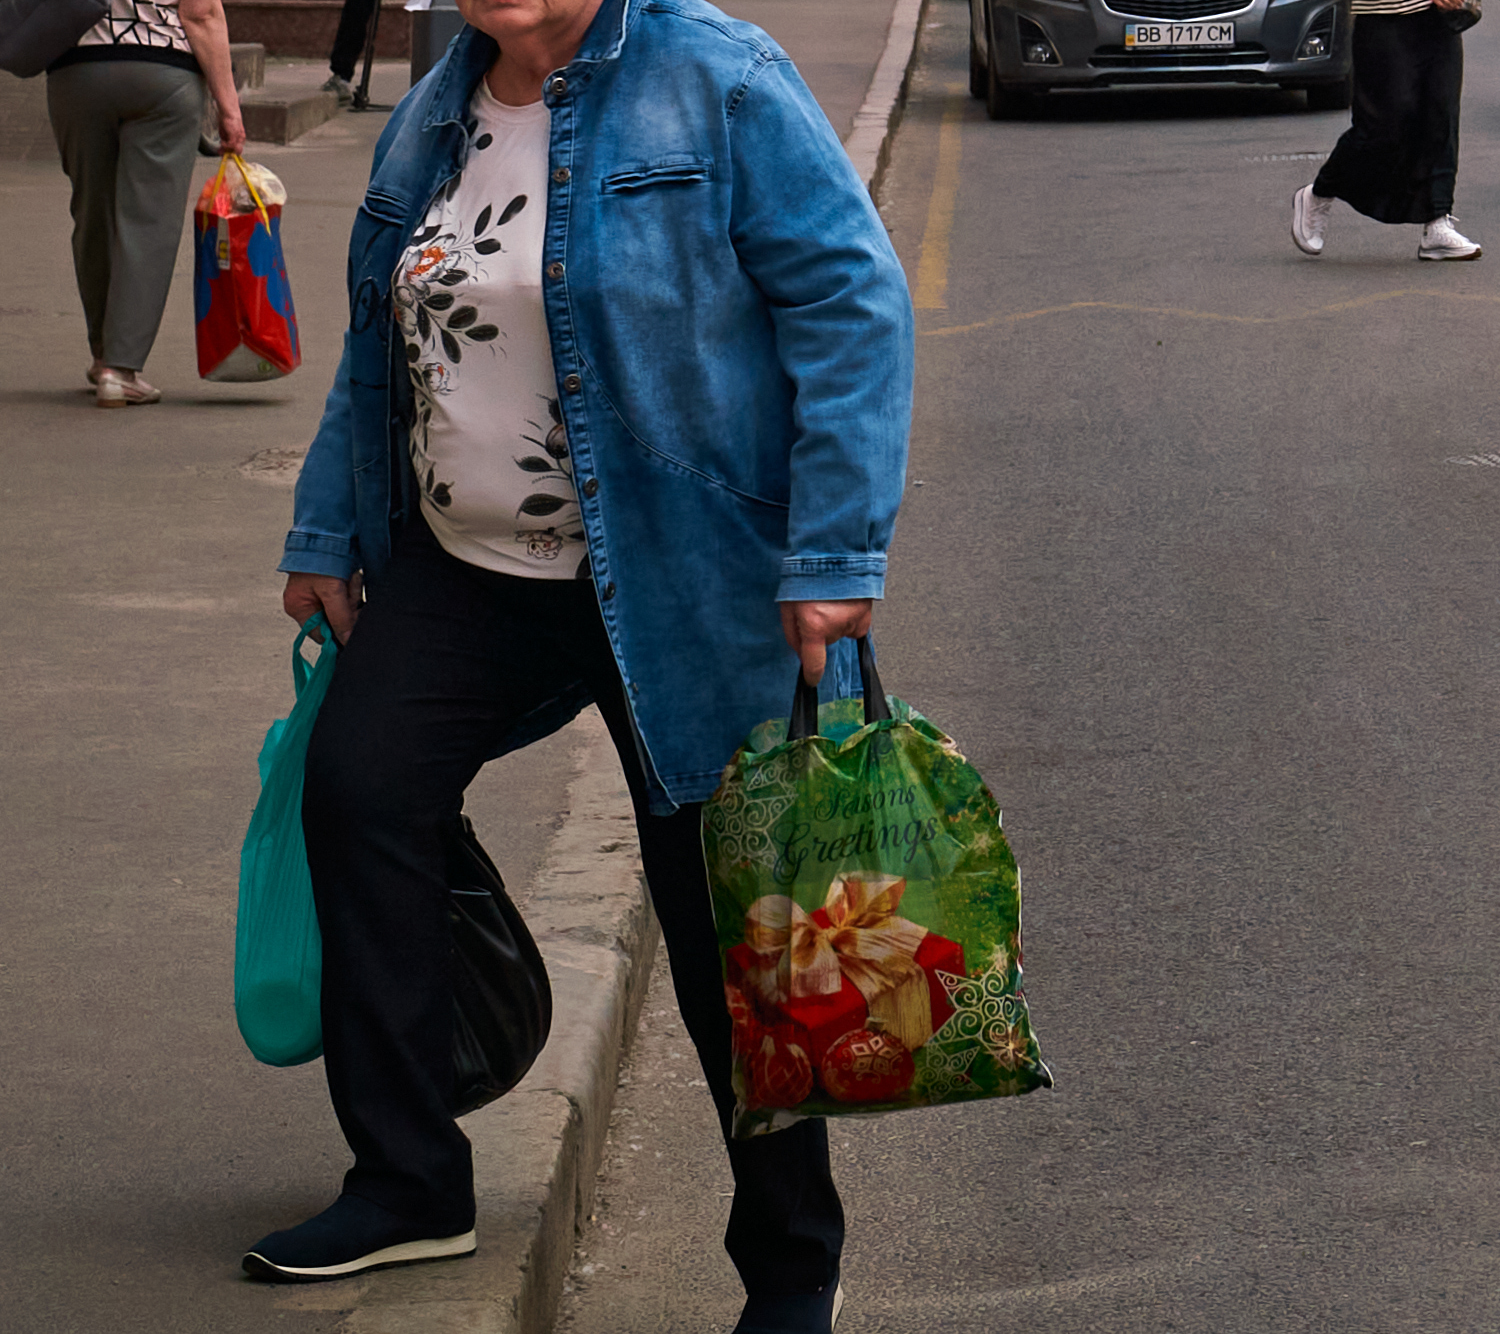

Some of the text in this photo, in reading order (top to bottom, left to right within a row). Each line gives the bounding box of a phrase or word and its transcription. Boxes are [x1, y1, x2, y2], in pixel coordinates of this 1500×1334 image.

[1137, 25, 1231, 43] BB 1717 CM
[773, 816, 938, 886] Greetings
